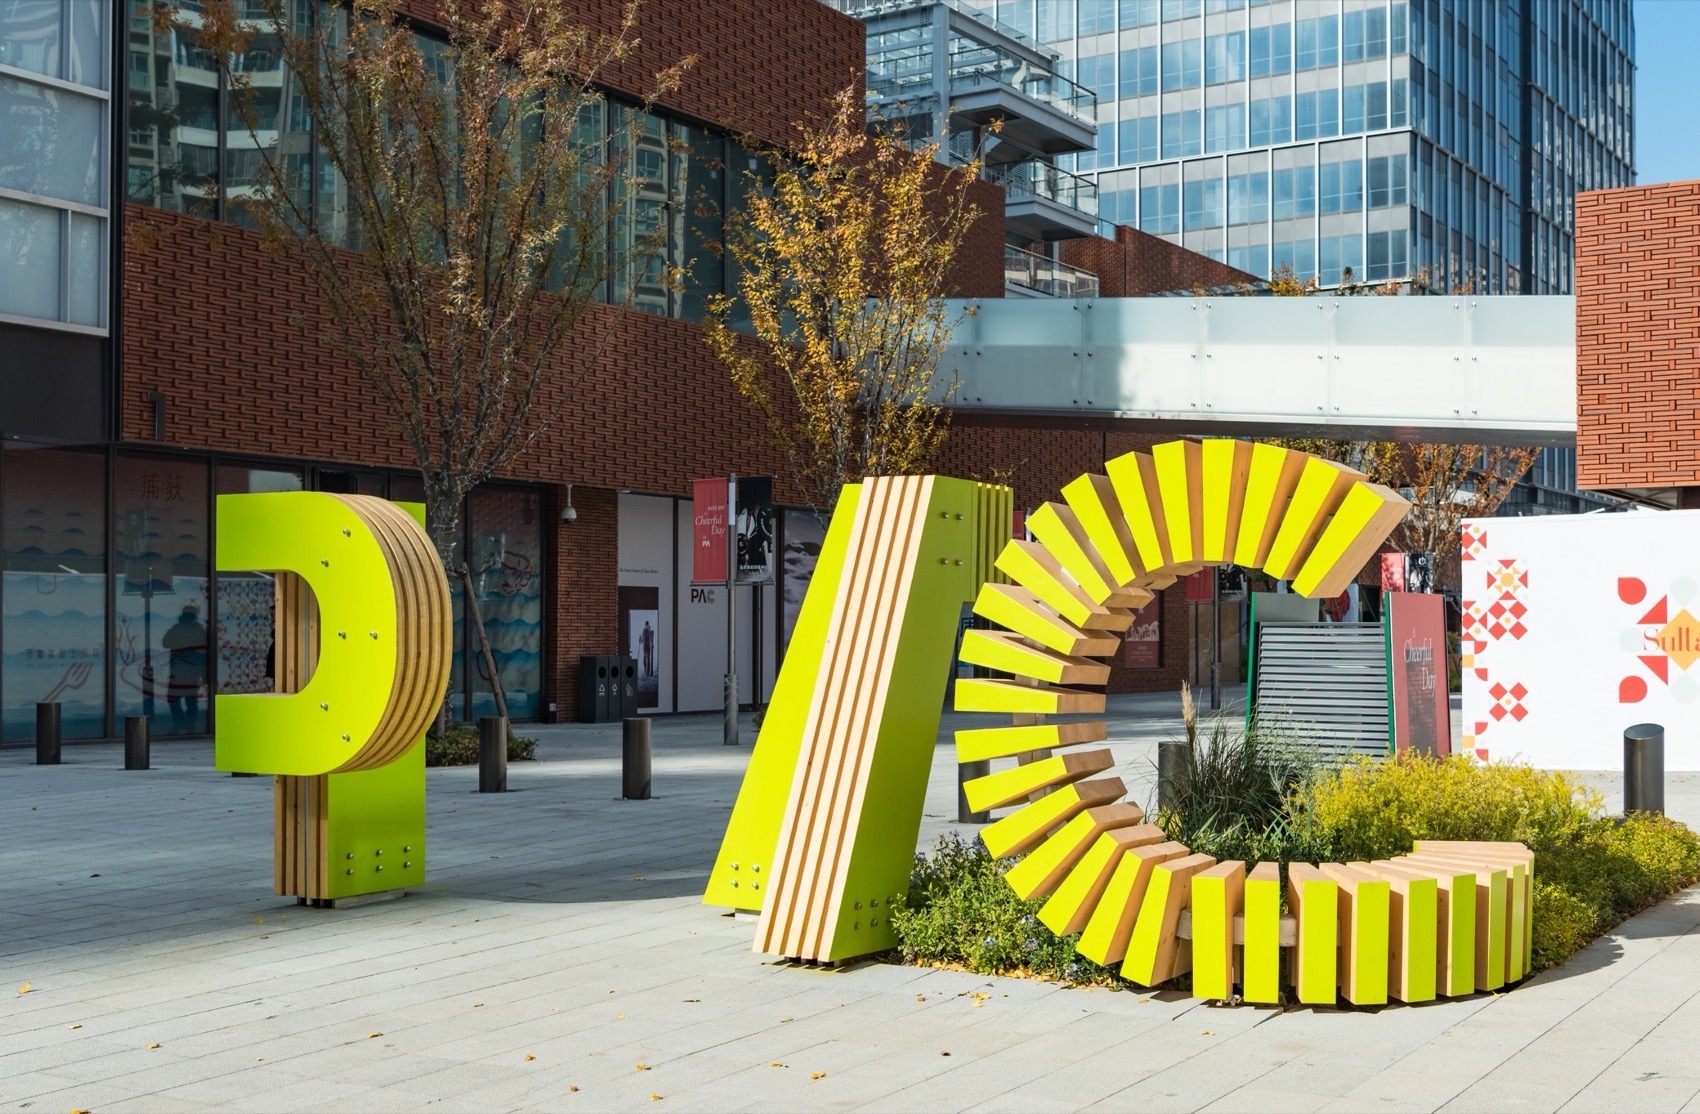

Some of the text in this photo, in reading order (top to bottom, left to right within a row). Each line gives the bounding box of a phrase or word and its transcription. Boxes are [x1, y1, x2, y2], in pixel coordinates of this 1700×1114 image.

[695, 514, 723, 527] Cheerful
[711, 525, 726, 538] Day
[691, 588, 716, 604] PAC
[1403, 637, 1432, 665] Cheerful
[1421, 667, 1437, 697] Day
